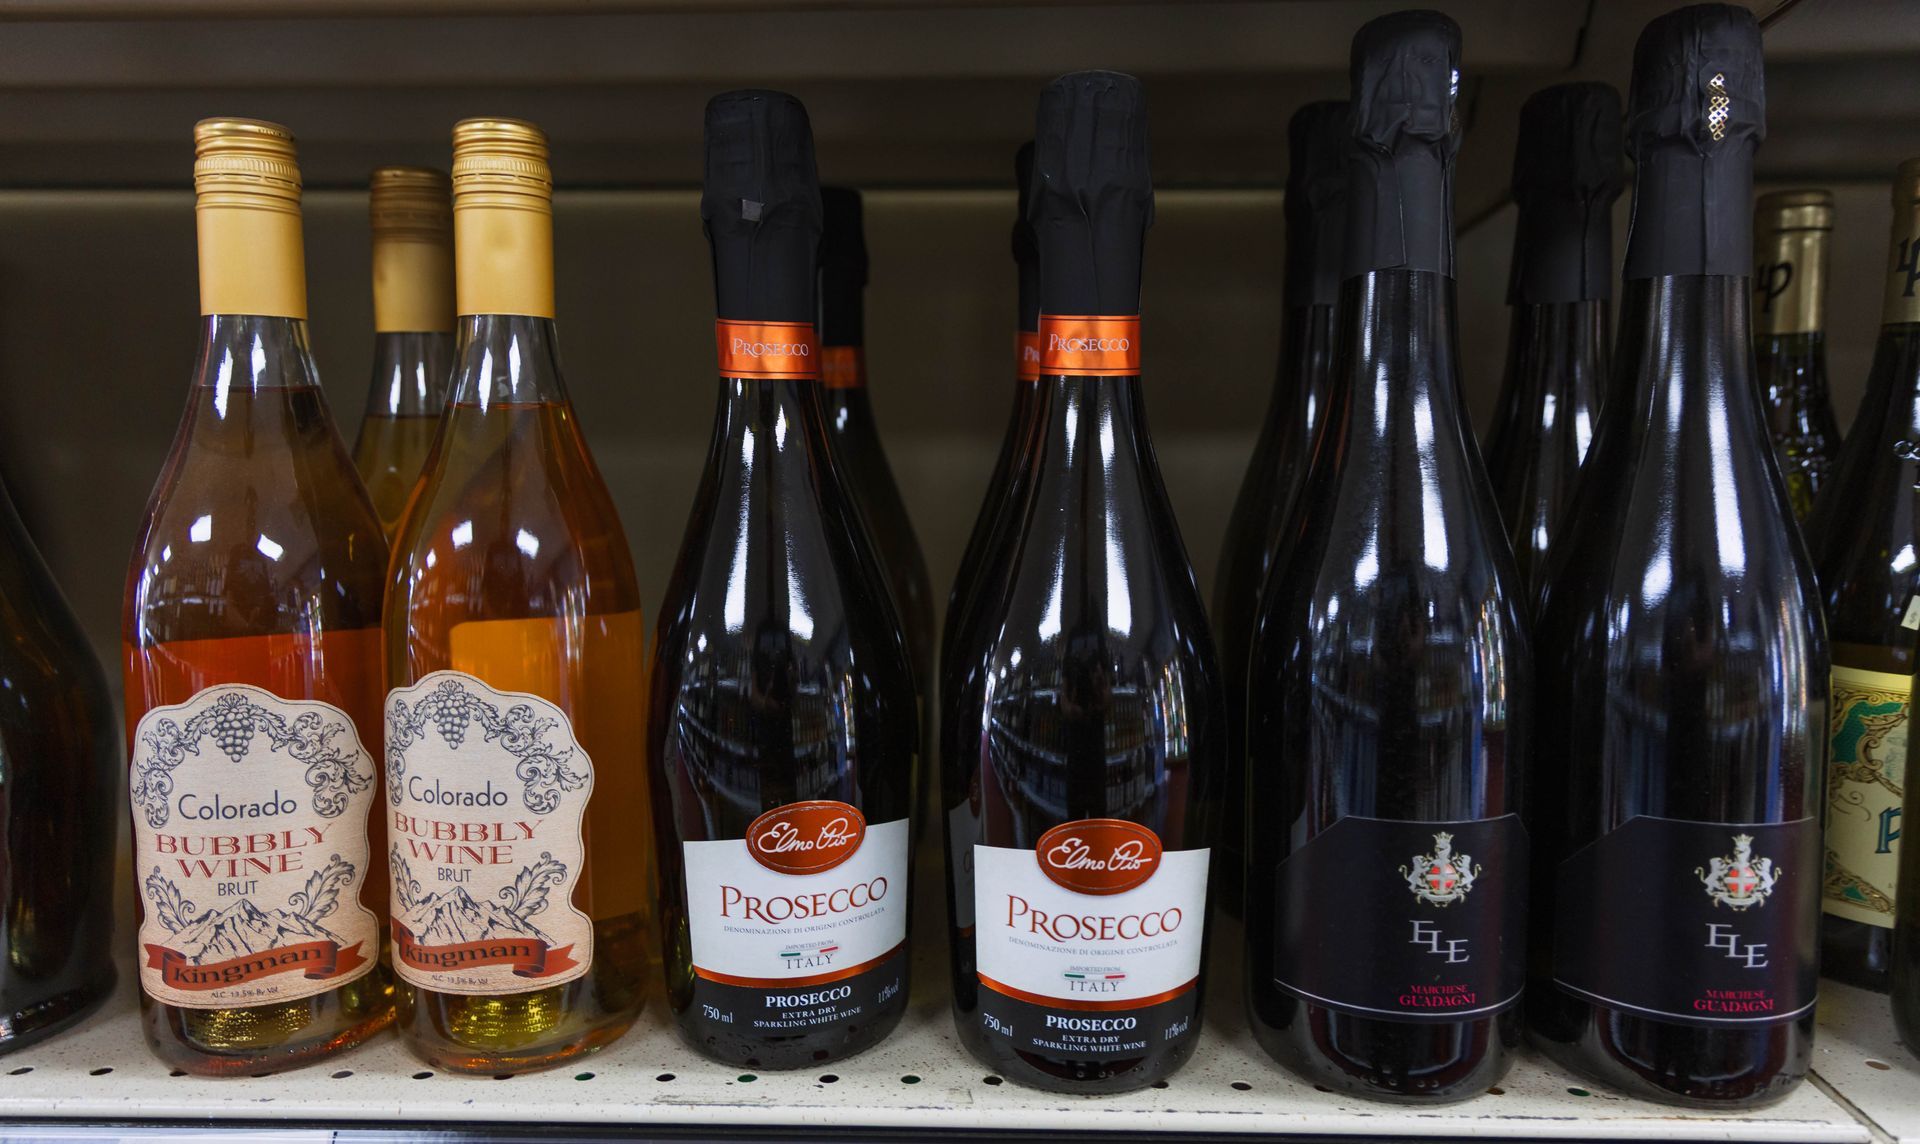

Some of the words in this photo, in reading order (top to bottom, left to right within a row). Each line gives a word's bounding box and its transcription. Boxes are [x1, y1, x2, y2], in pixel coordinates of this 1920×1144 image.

[732, 338, 809, 358] PROSECCO
[1048, 333, 1130, 353] PROSECCO
[408, 776, 508, 806] Colorado
[178, 790, 297, 820] Colorado
[394, 811, 544, 842] BUBBLY
[757, 821, 813, 853] Elmo
[815, 817, 857, 850] Pio
[155, 823, 333, 856] BUBBLY
[407, 839, 513, 865] WINE
[1046, 837, 1105, 869] Elmo
[1106, 840, 1152, 871] Pio
[176, 851, 304, 878] WINE
[437, 867, 471, 883] BRUT
[217, 880, 258, 897] BRUT
[719, 876, 888, 924] PROSECCO
[723, 925, 792, 935] DENOMINAZIONE
[804, 922, 837, 933] ORIGINE
[838, 907, 886, 927] CONTROLLATA
[1005, 894, 1183, 943] PROSECCO
[785, 941, 817, 950] IMPORTED
[817, 939, 835, 947] FROM
[1008, 936, 1078, 955] DENOMINAZIONE
[1090, 948, 1126, 956] ORIGINE
[1126, 939, 1178, 955] CONTROLLATA
[787, 954, 833, 970] ITALY
[765, 985, 852, 1008] PROSECCO
[1070, 981, 1120, 993] ITALY
[702, 1004, 720, 1021] 750
[721, 1011, 734, 1024] ml
[753, 1019, 808, 1028] SPARKLING
[808, 1013, 840, 1026] WHITE
[840, 1006, 863, 1019] WINE
[782, 1010, 815, 1019] EXTRA
[818, 1005, 837, 1015] DRY
[1045, 1014, 1137, 1032] PROSECCO
[983, 1012, 1000, 1031] 750
[1001, 1024, 1013, 1037] ml
[1032, 1038, 1087, 1052] SPARKLING
[1089, 1043, 1122, 1052] WHITE
[1122, 1040, 1147, 1050] WINE
[1062, 1034, 1097, 1044] EXTRA
[1099, 1035, 1121, 1043] DRY
